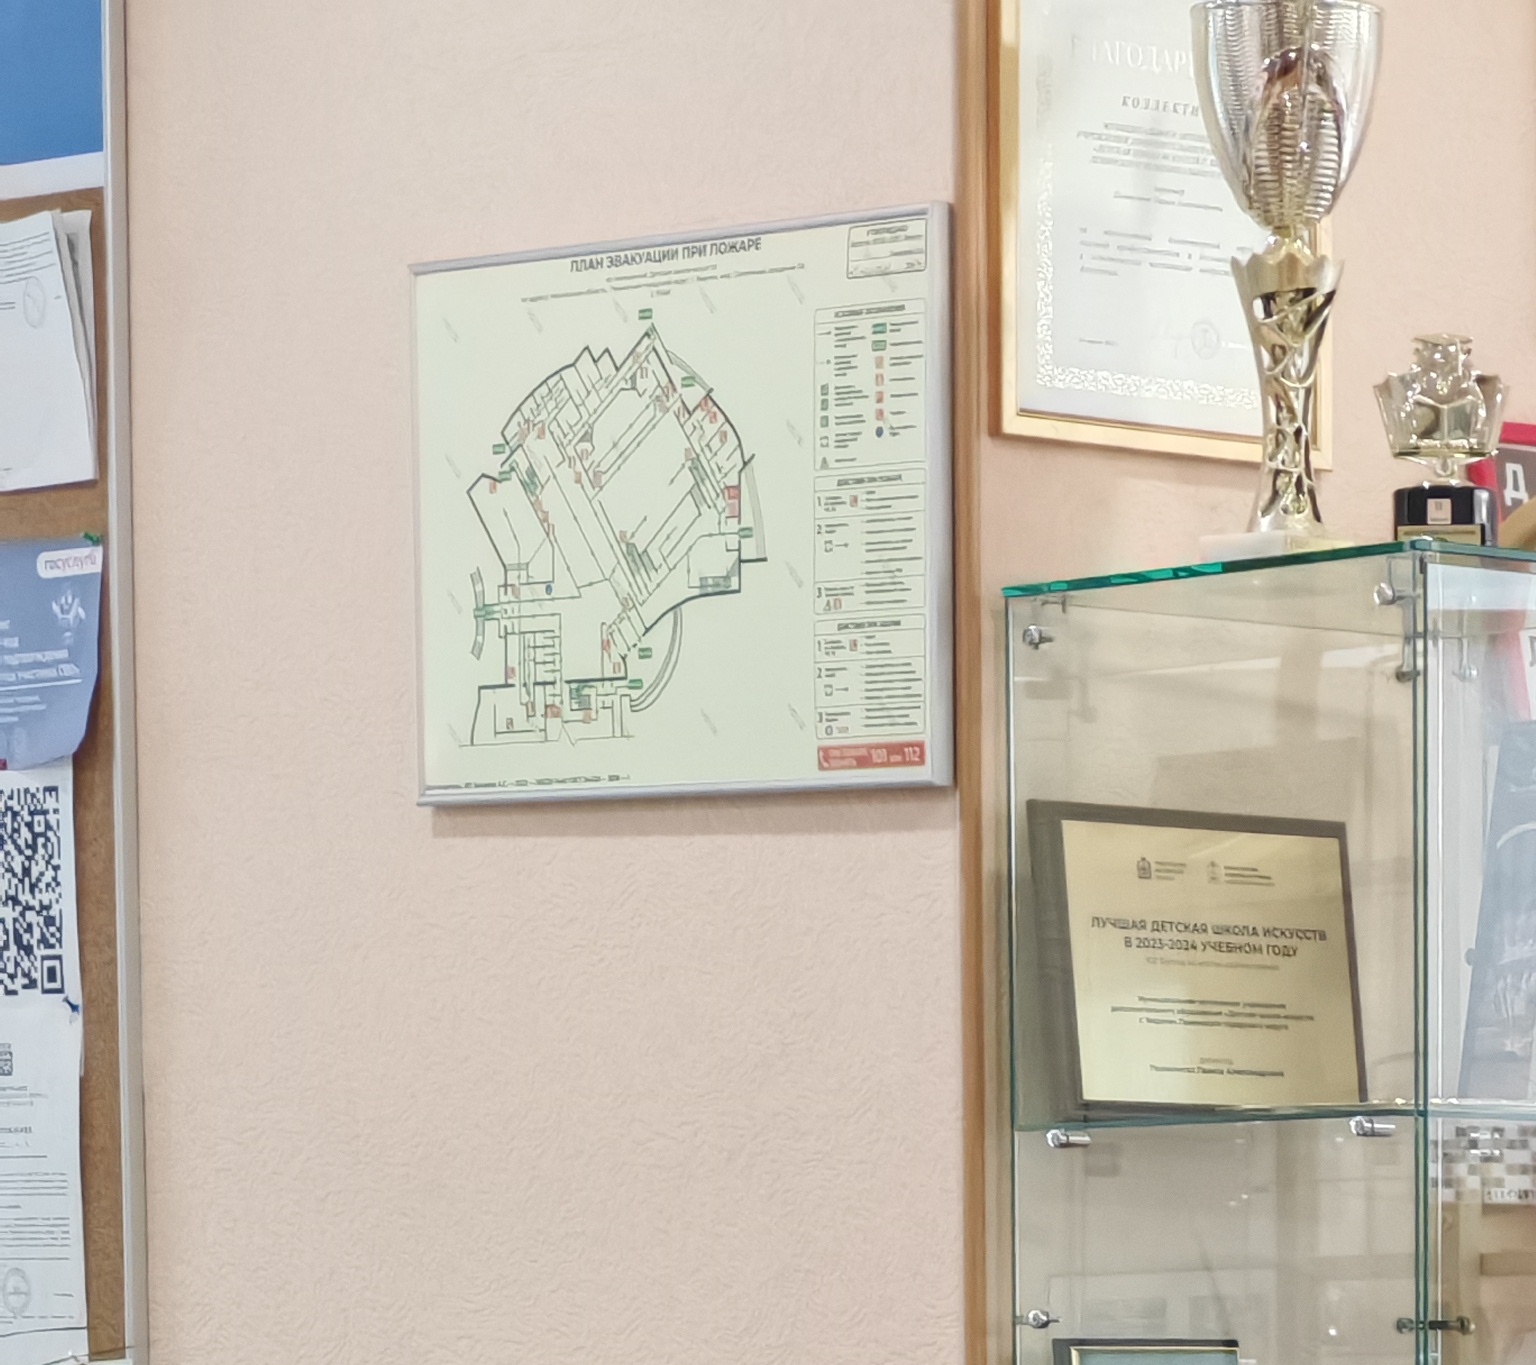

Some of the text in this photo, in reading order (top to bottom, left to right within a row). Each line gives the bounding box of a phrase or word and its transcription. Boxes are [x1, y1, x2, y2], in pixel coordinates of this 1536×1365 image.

[570, 236, 762, 273] ПЛАН ЭВАКУАЦИИ ПРИ ПОЖАРЕ
[1091, 916, 1328, 942] ЛУЧШАЯ ДЕТСКАЯ ШКОЛА ИСКУССТВ
[1123, 936, 1133, 949] В
[1200, 940, 1264, 955] УЧЕБНОМ
[1266, 943, 1299, 958] ГОДУ
